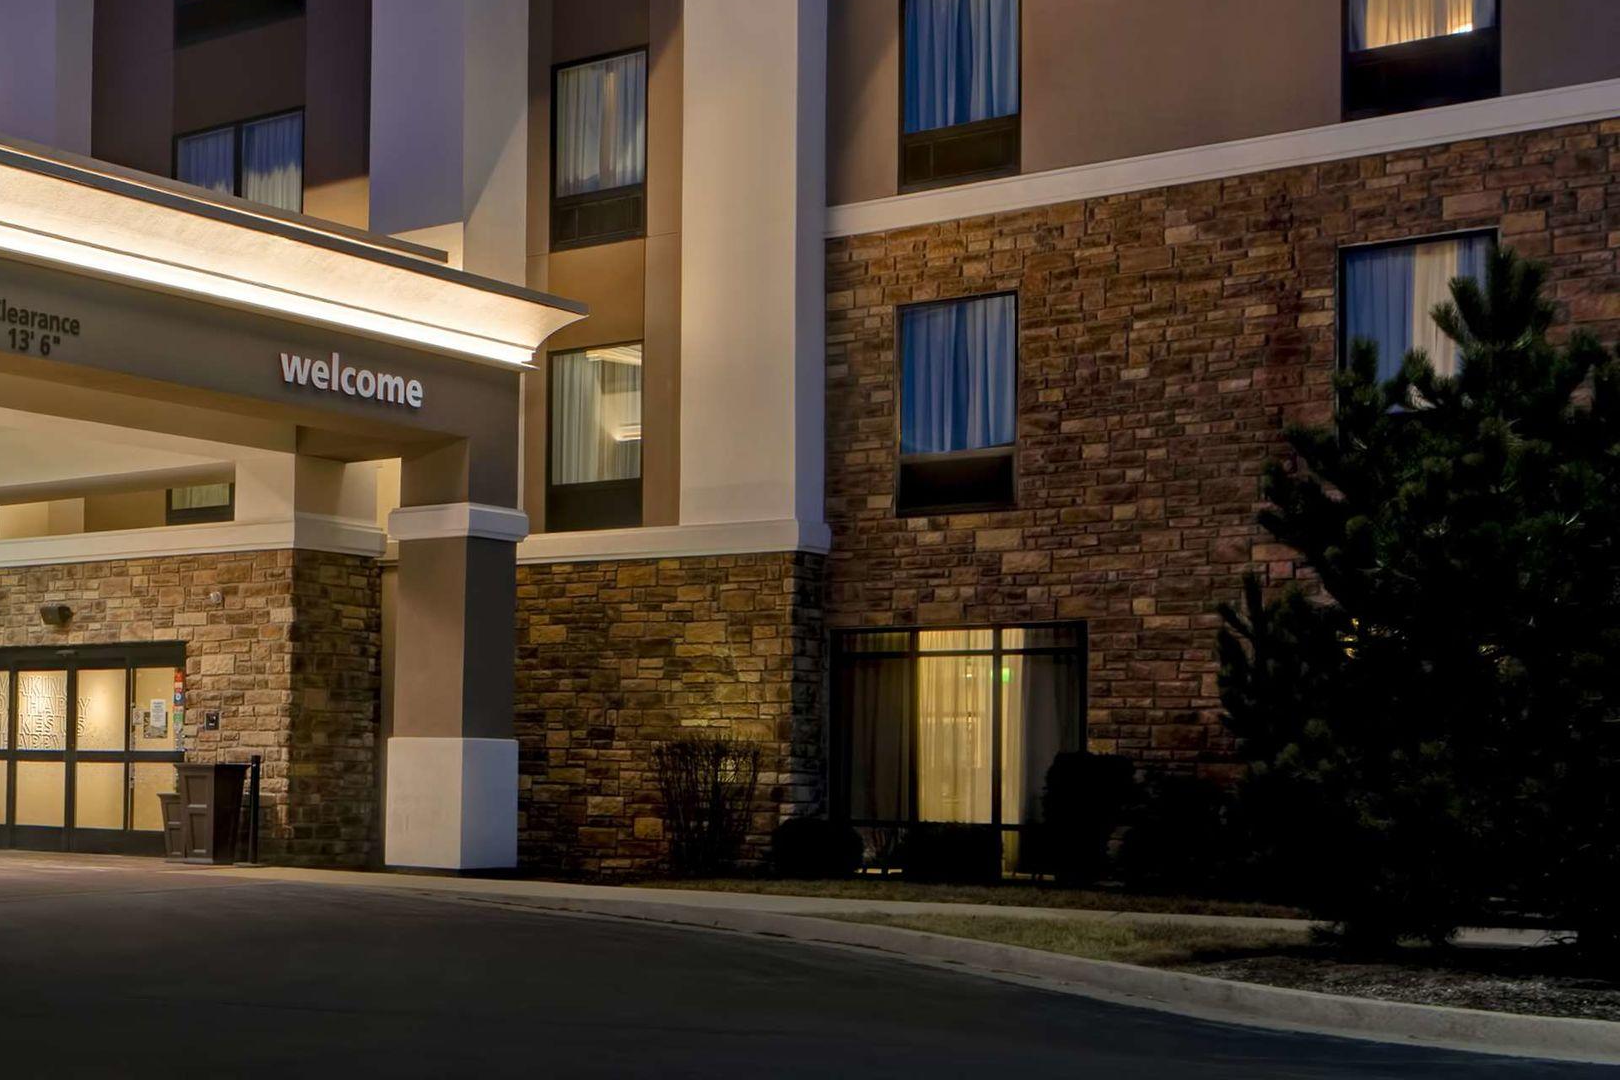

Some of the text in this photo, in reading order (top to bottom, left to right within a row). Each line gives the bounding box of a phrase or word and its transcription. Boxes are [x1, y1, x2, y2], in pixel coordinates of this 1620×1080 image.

[8, 327, 61, 357] 13' 6"
[279, 351, 424, 407] welcome
